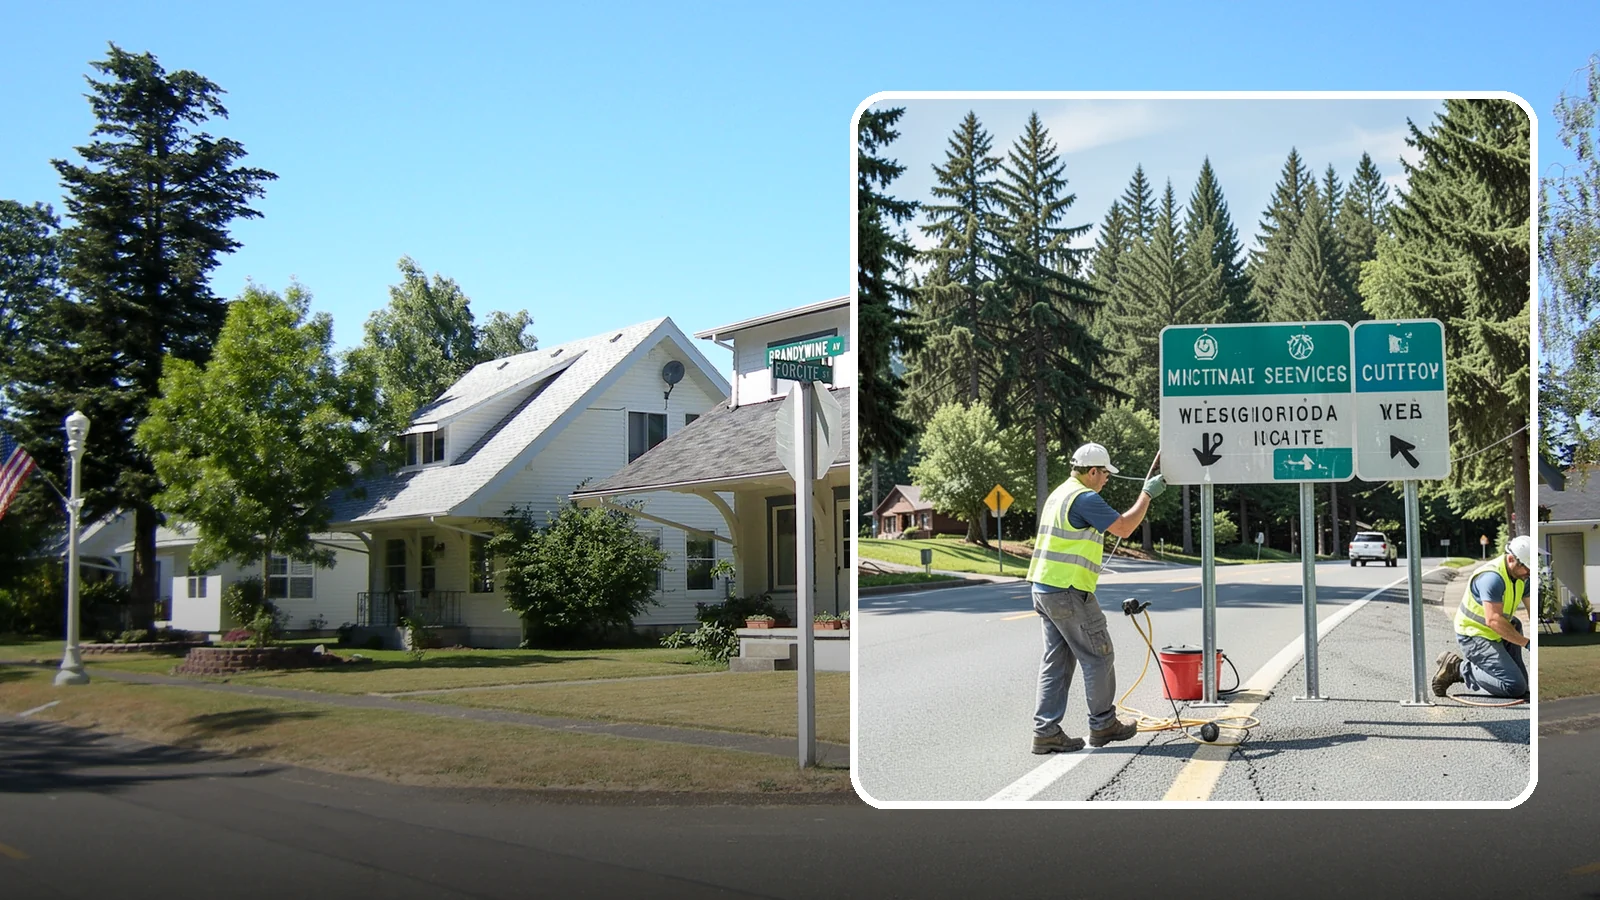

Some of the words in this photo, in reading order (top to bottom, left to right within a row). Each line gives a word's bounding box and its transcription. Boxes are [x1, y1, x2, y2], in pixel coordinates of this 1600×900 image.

[769, 341, 828, 364] BRANDYWINE
[832, 342, 841, 352] AV
[775, 362, 819, 380] FORCITE
